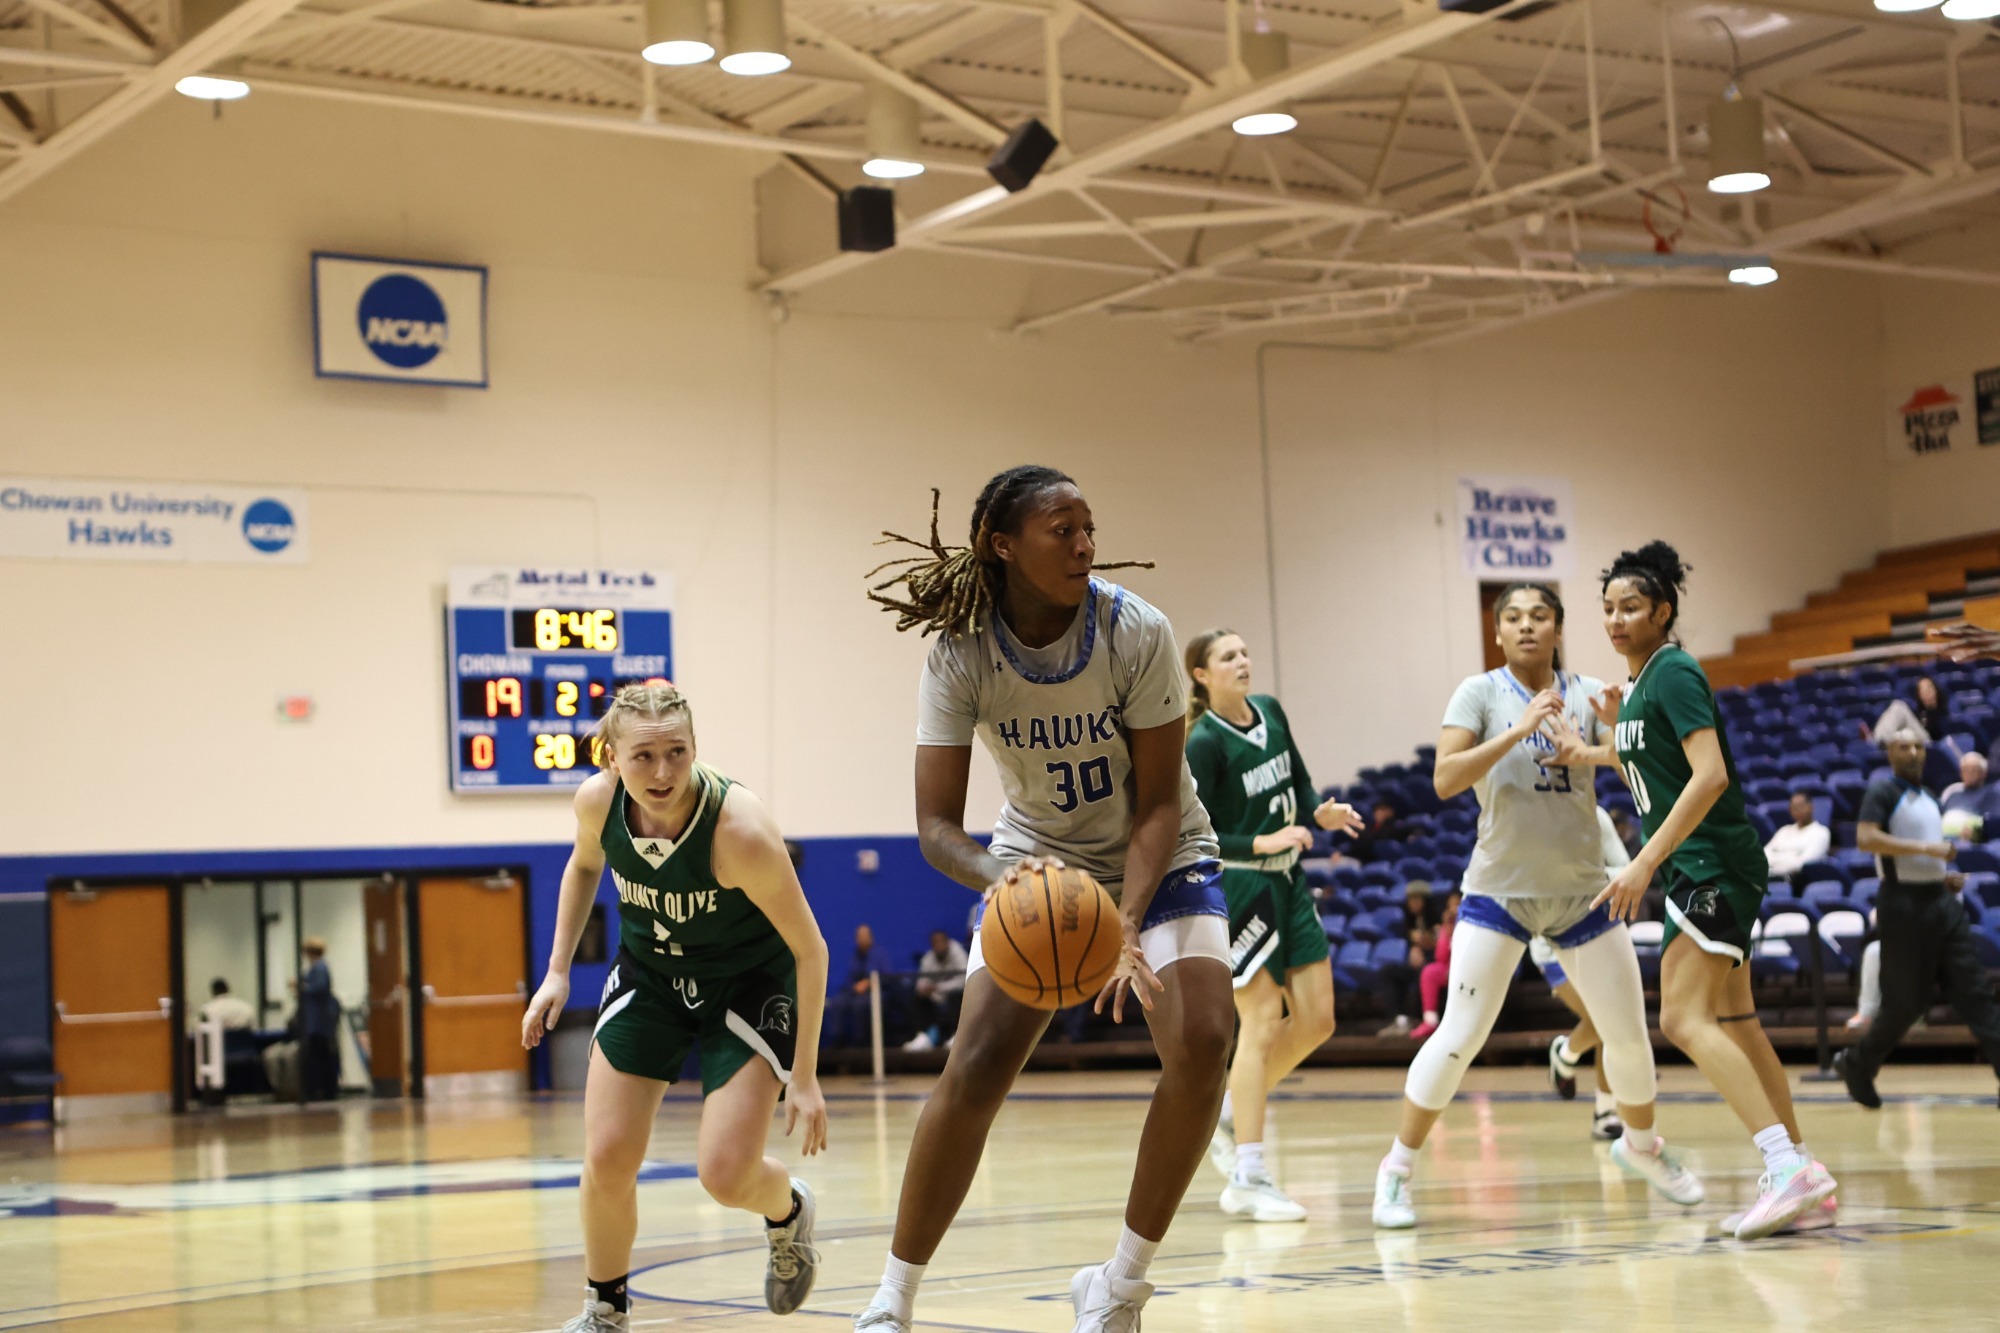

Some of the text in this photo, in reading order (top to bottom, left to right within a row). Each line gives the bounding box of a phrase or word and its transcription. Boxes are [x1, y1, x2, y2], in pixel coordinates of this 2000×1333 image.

[366, 316, 448, 350] NCAA
[1, 488, 235, 521] Chowan University
[1470, 488, 1556, 516] Brave
[68, 518, 173, 546] Hawks
[1466, 516, 1565, 542] Hawks
[1483, 543, 1552, 568] Club
[516, 570, 655, 586] Metal Tech
[534, 608, 618, 652] 8:46
[612, 655, 667, 676] GUEST
[485, 677, 523, 718] 19
[555, 681, 579, 717] 2
[471, 734, 494, 770] 0
[533, 733, 576, 770] 20
[1046, 755, 1114, 814] 30
[664, 889, 719, 924] OLIVE
